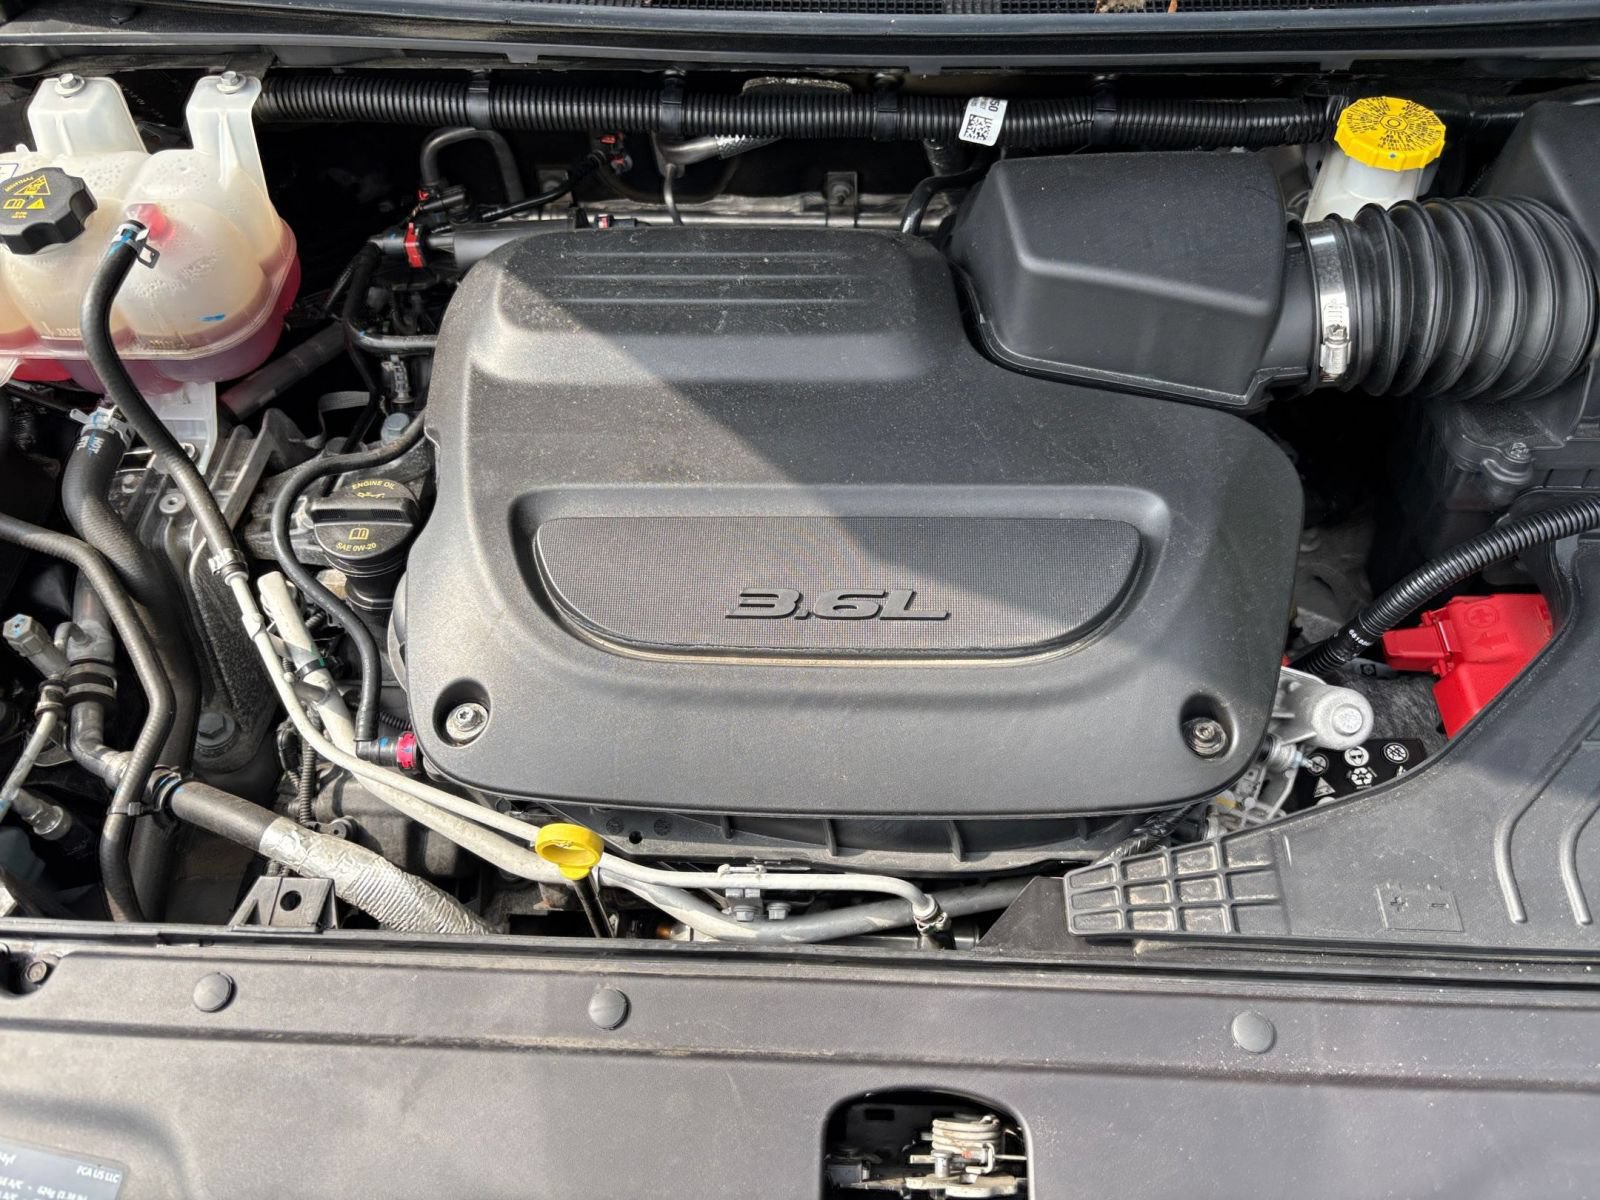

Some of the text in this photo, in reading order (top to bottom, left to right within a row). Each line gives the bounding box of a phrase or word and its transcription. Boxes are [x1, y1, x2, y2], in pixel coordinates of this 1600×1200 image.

[352, 480, 396, 490] ENGINE OIL
[336, 542, 377, 552] SAE 0W-20
[725, 588, 952, 620] 3.6L
[76, 1165, 120, 1184] FCA US LLC
